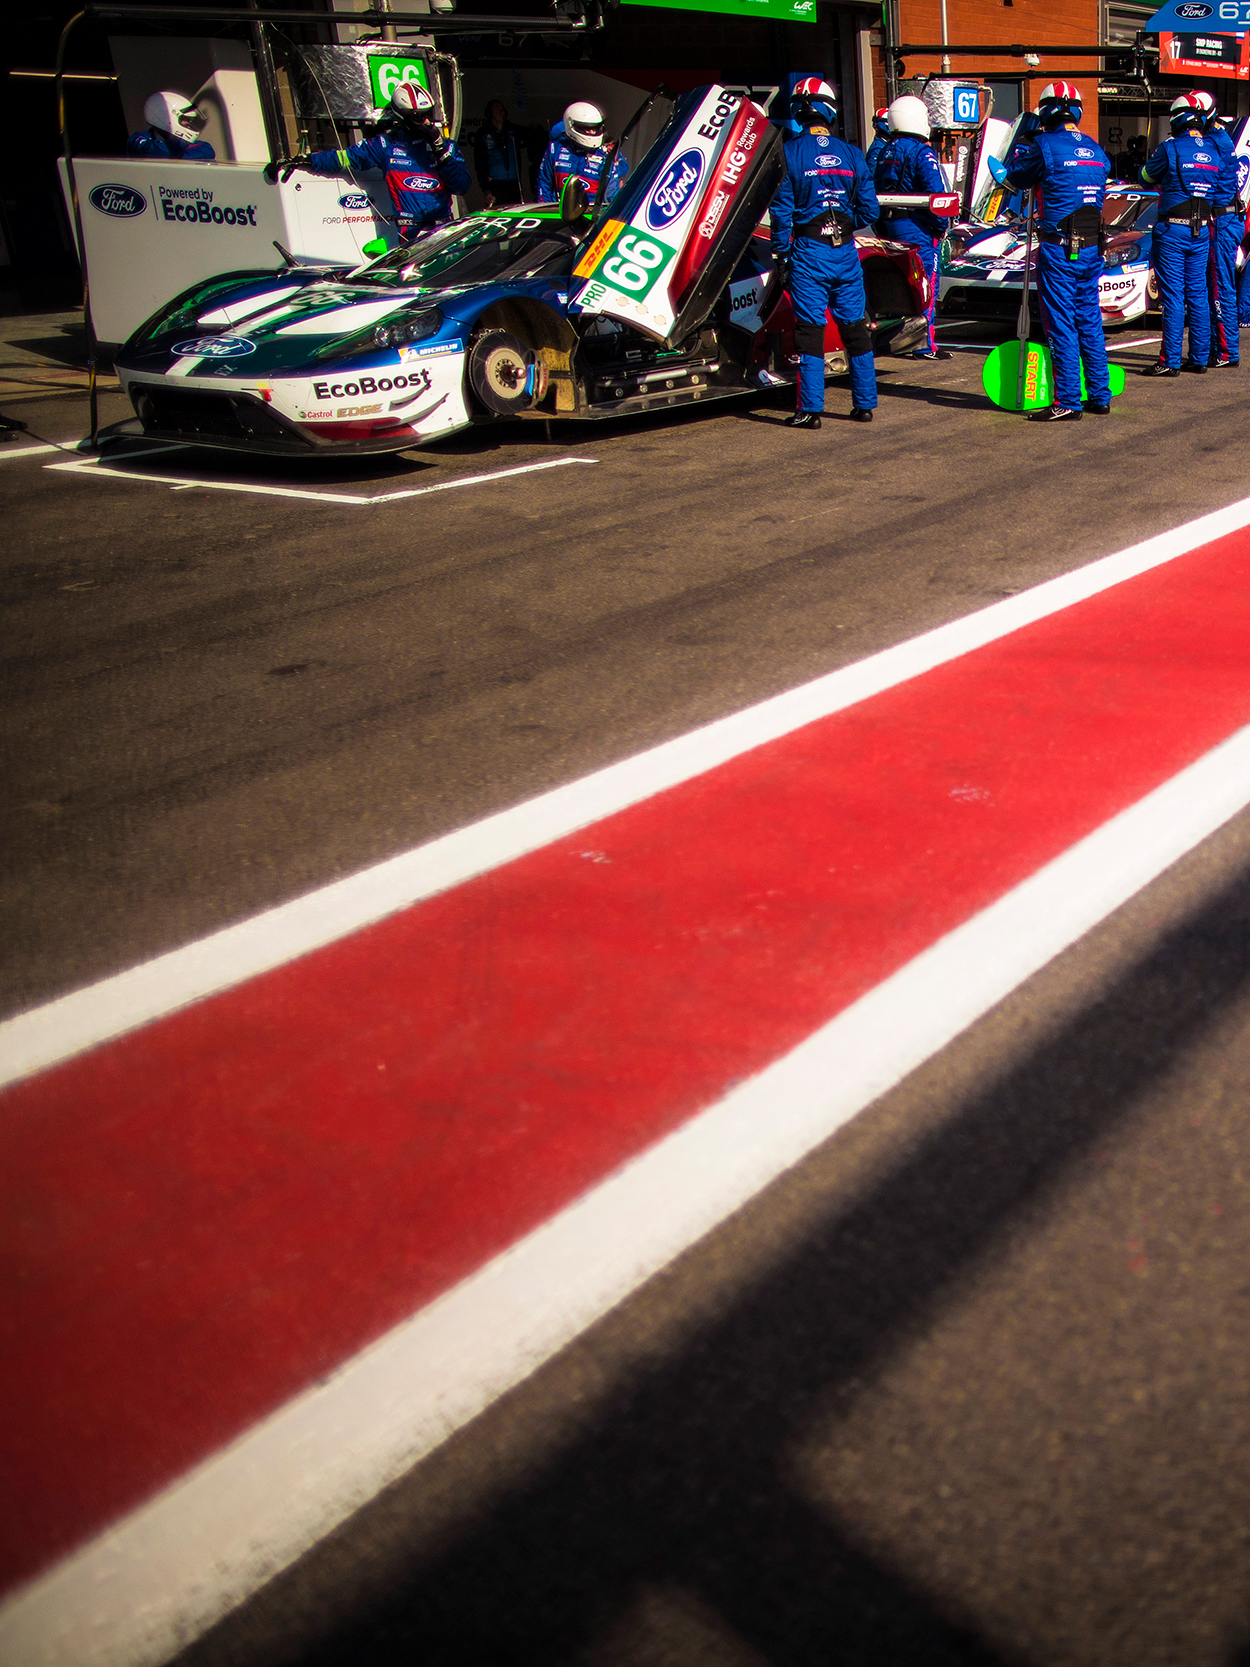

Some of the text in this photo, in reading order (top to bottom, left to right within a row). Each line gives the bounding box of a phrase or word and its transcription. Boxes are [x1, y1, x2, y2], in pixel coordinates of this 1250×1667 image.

[1181, 3, 1206, 17] Ford
[1170, 41, 1181, 59] 17
[957, 92, 977, 118] 67
[736, 116, 756, 148] Rewards
[744, 132, 757, 151] Club
[721, 150, 746, 185] IHG
[1236, 161, 1249, 188] ord
[410, 177, 434, 189] Ford
[654, 161, 697, 217] Ford
[101, 187, 136, 213] Ford
[158, 186, 214, 203] Powered by
[345, 194, 369, 208] Ford
[932, 196, 958, 209] GT
[161, 198, 257, 226] EcoBoost
[323, 216, 342, 225] FORD
[342, 214, 395, 224] PERFORMANCE
[584, 231, 615, 269] DHL
[602, 234, 663, 292] 66
[581, 282, 607, 308] PRO
[1098, 277, 1138, 292] oBoost
[733, 287, 758, 311] oost
[184, 337, 242, 356] Ford
[420, 343, 458, 356] MICHELIN
[313, 368, 431, 400] EcoBoost
[1025, 351, 1039, 402] START
[307, 409, 333, 419] Castrol
[337, 403, 383, 418] EDGE
